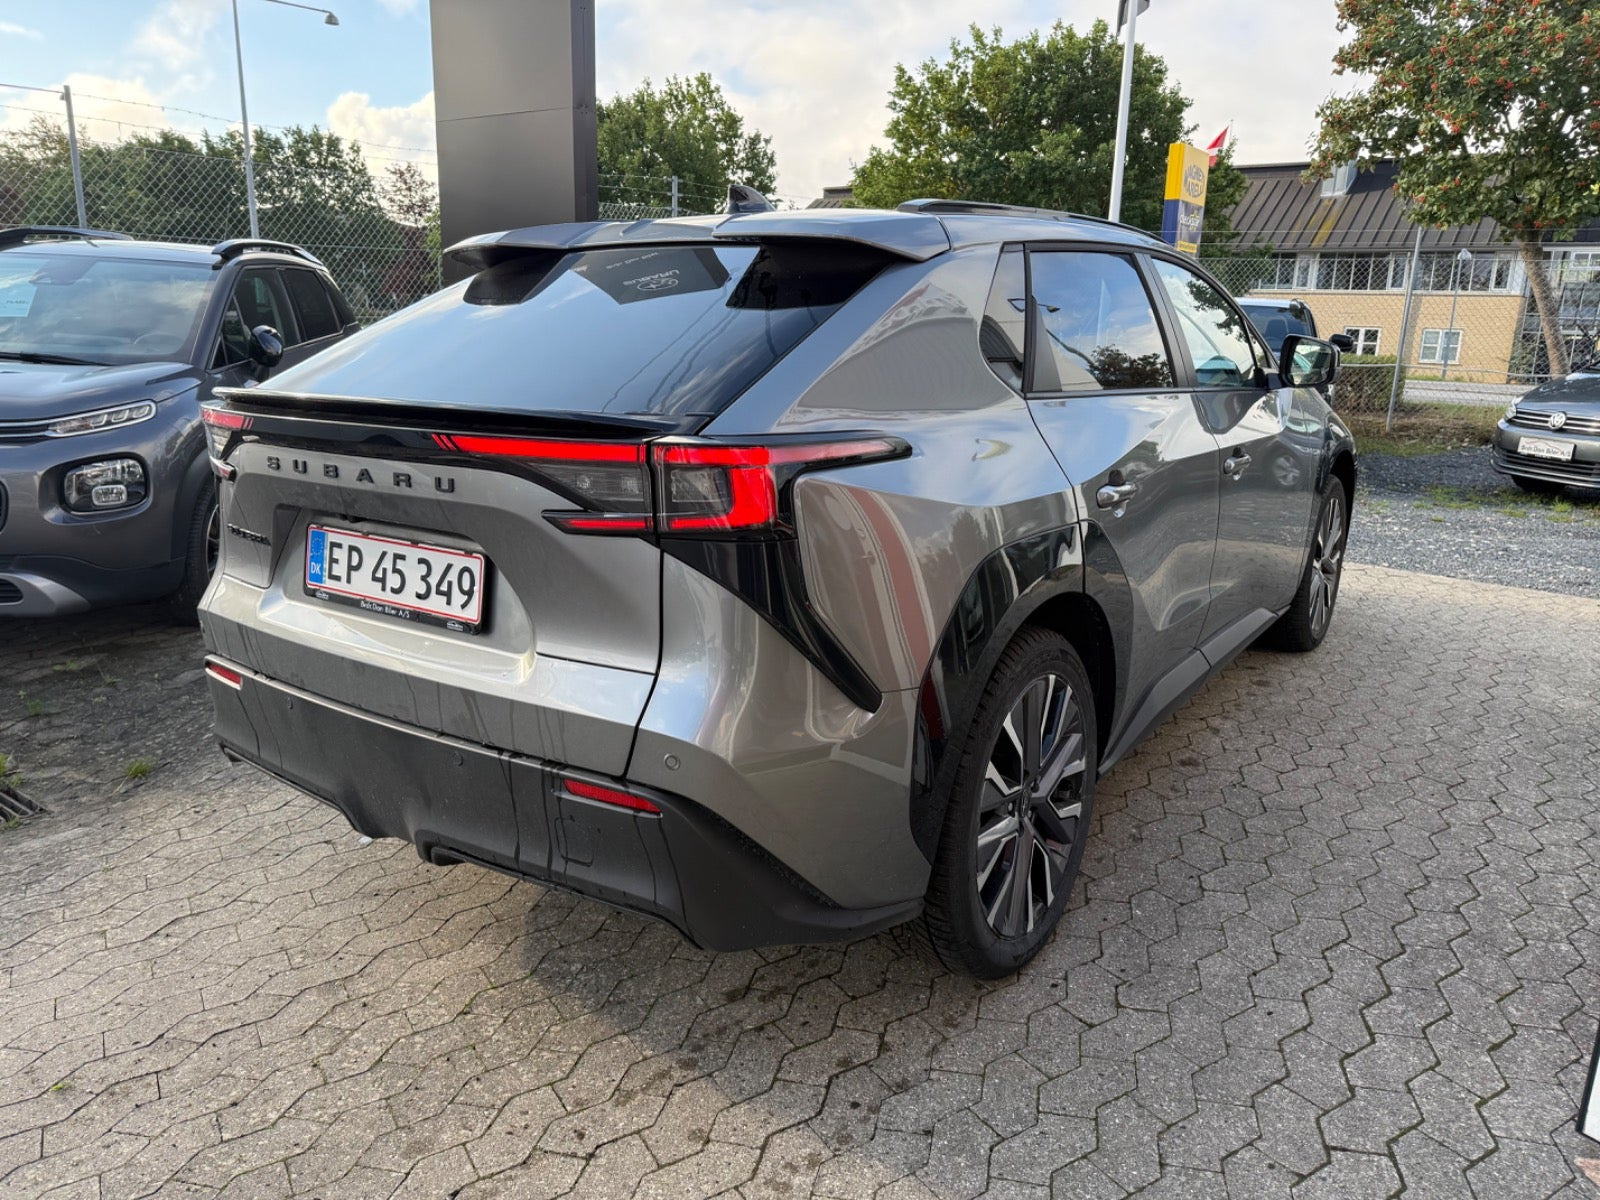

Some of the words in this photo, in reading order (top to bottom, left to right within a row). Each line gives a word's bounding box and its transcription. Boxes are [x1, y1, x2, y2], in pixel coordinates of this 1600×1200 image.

[267, 456, 455, 493] SUBARU
[310, 562, 321, 575] DK
[328, 541, 363, 584] EP
[371, 550, 407, 595] 45
[415, 557, 476, 610] 349
